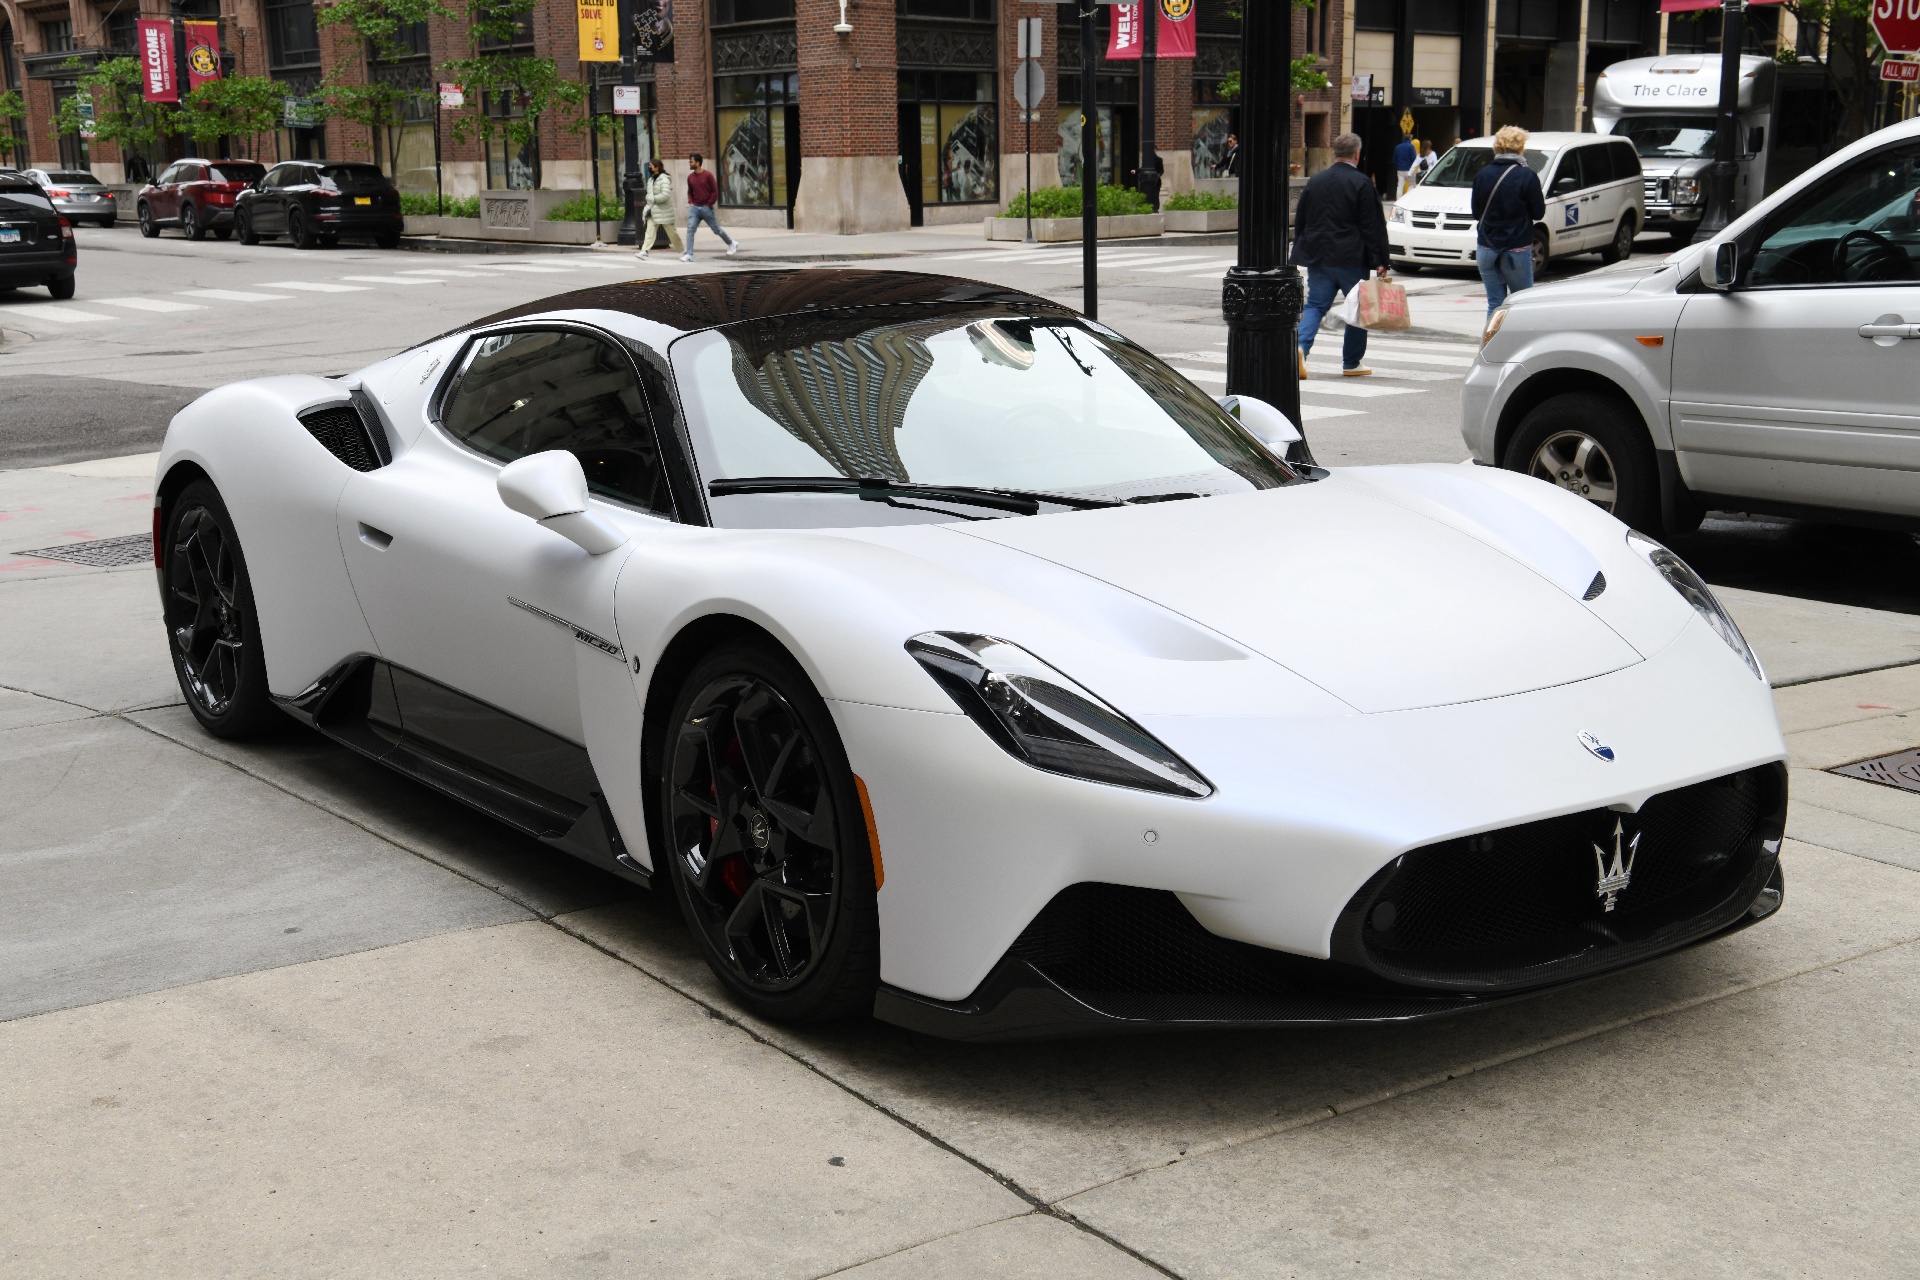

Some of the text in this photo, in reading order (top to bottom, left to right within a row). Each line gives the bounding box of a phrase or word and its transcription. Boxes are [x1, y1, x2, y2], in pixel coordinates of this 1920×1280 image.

[581, 9, 602, 19] SOLVE
[145, 28, 164, 94] WELCOME
[159, 32, 171, 90] WATER TOWER CAMPUS
[1885, 64, 1917, 78] ALL WAY
[1420, 88, 1445, 97] Private Parking
[1633, 84, 1708, 96] The Clare
[1380, 301, 1407, 317] PINK
